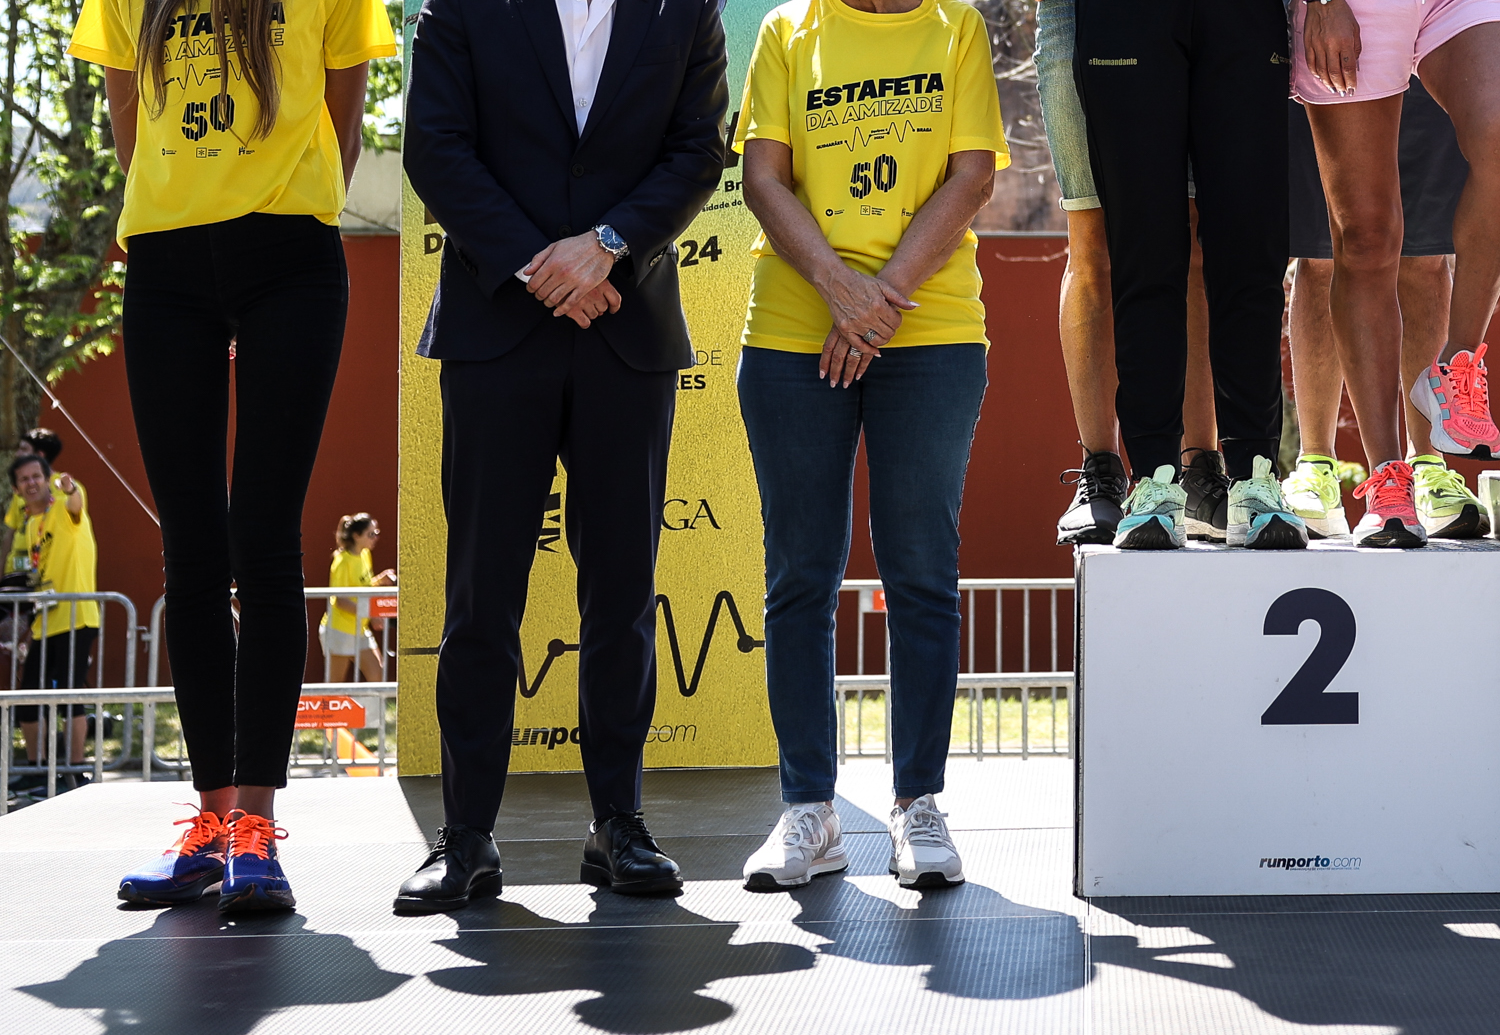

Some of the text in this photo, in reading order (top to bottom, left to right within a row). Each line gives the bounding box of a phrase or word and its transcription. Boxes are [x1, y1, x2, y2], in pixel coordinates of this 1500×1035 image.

[806, 72, 945, 111] ESTAFETA
[181, 92, 235, 142] 50
[805, 95, 943, 132] DA AMIZADE
[849, 153, 898, 199] 50
[701, 200, 730, 212] sidade
[424, 234, 443, 255] D
[680, 235, 723, 268] 24
[697, 350, 722, 366] DE
[1260, 586, 1360, 726] 2
